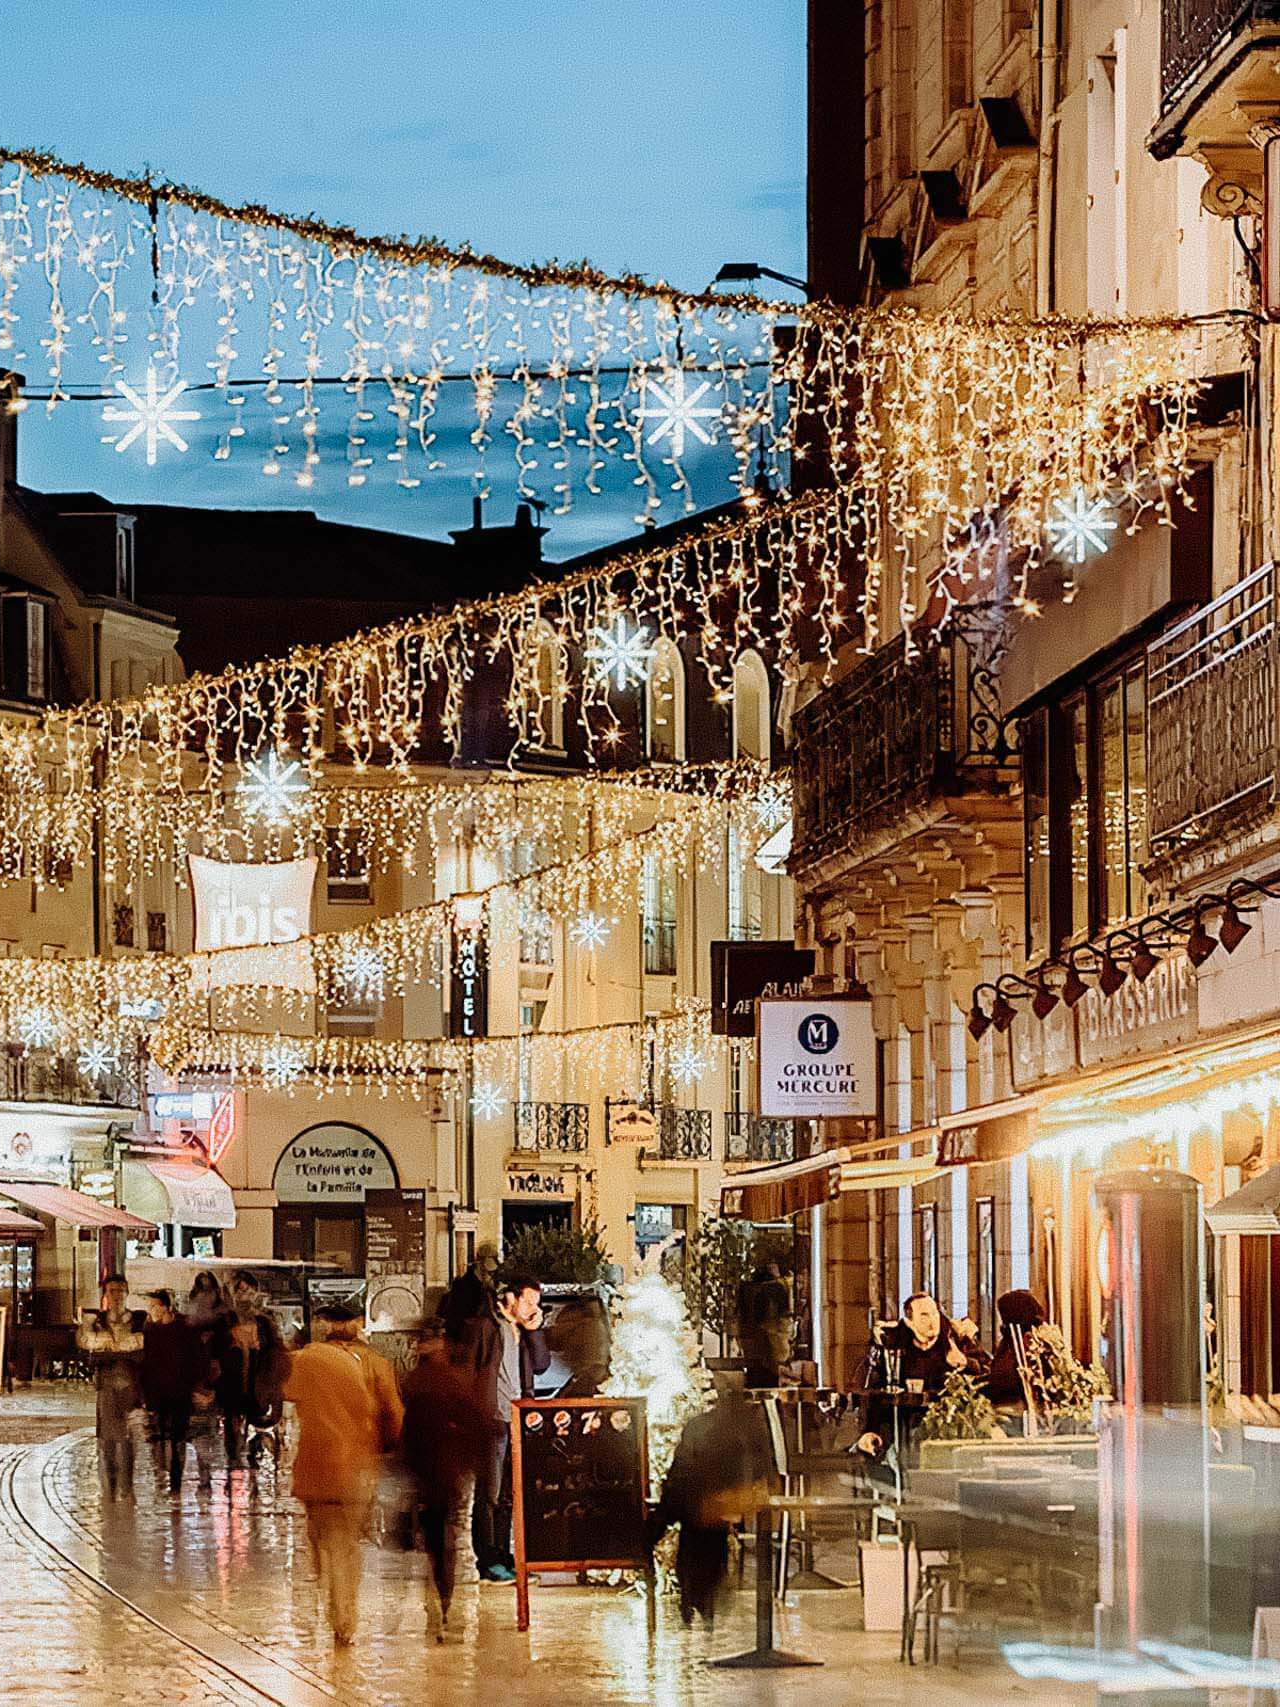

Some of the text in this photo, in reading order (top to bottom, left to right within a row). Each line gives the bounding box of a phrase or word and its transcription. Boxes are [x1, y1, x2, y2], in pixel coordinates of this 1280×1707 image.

[208, 895, 299, 945] ibis
[783, 1063, 856, 1077] GROUPE
[777, 1079, 860, 1093] MERCURE
[292, 1146, 376, 1159] La Mutuelle de
[343, 1165, 356, 1176] et
[358, 1165, 373, 1176] de
[321, 1180, 363, 1193] Famille
